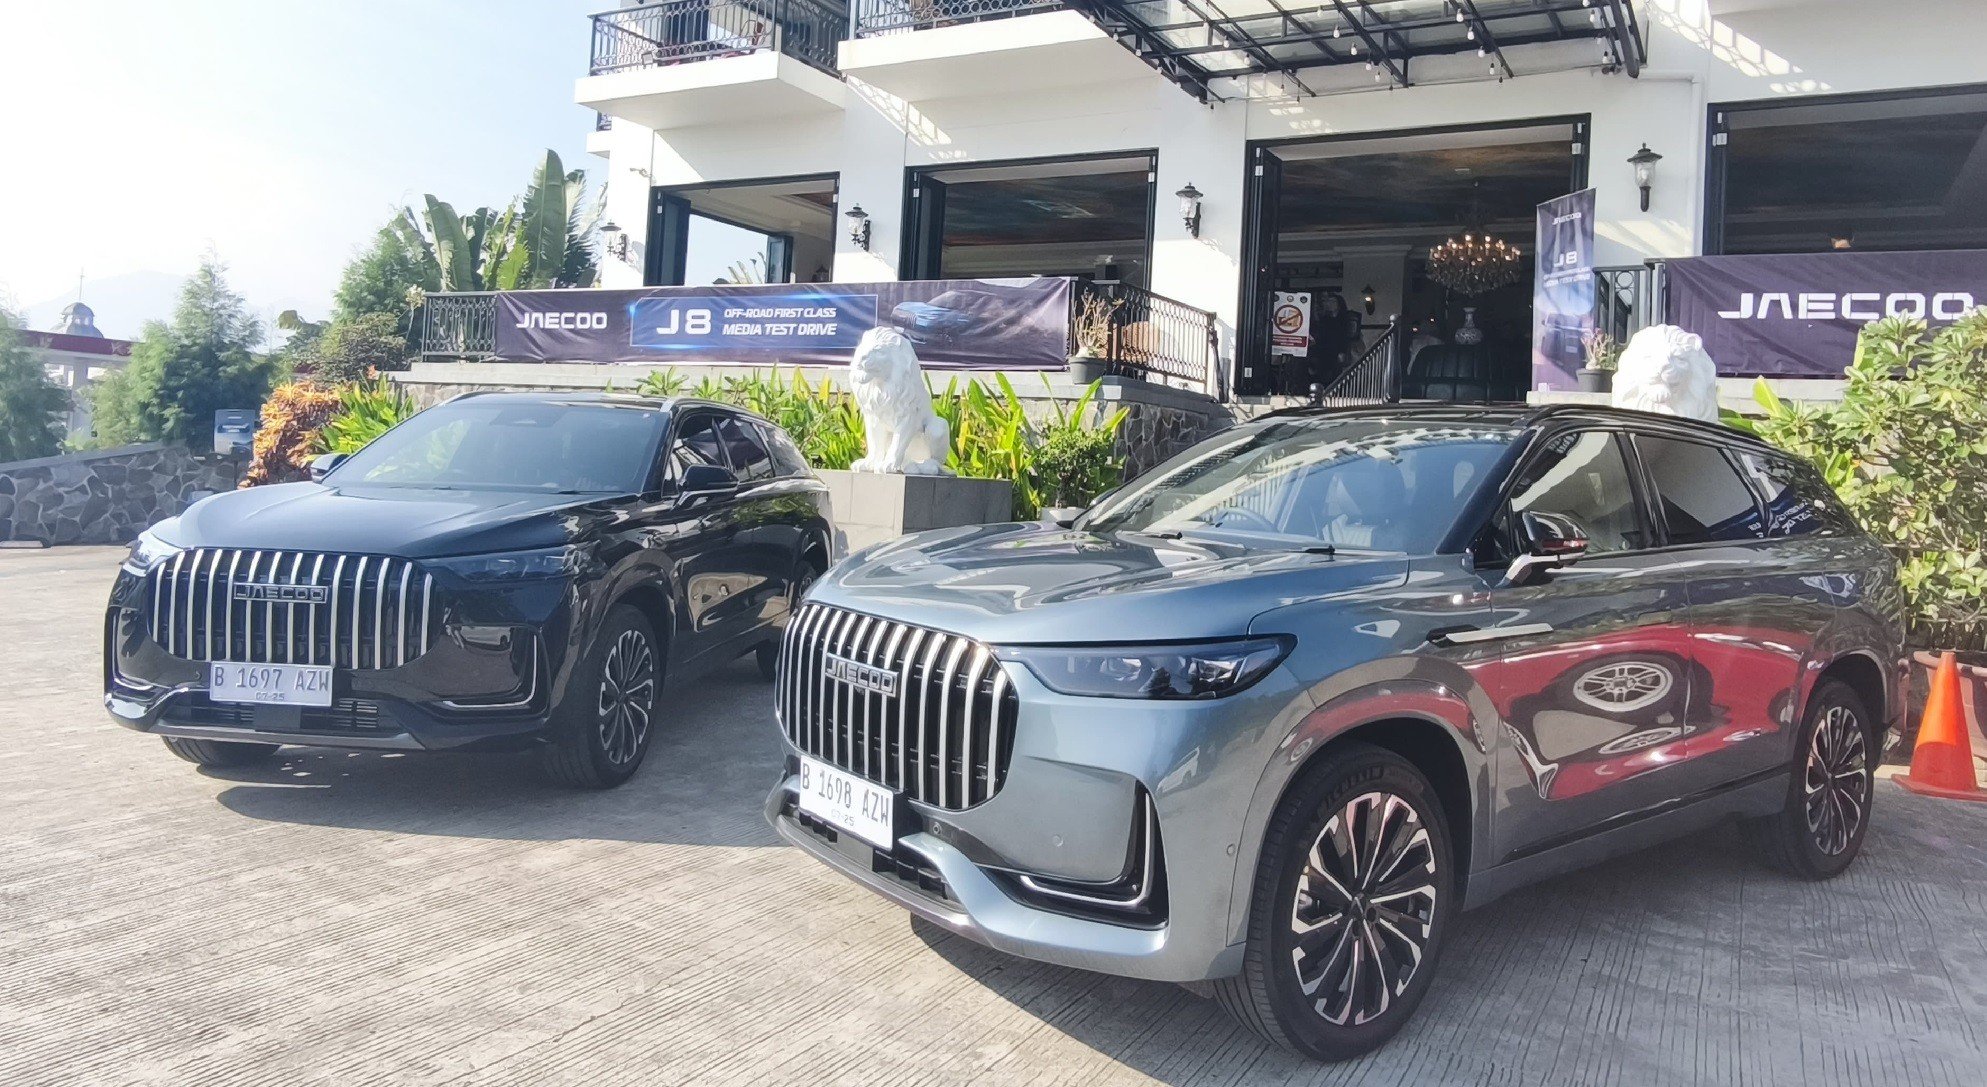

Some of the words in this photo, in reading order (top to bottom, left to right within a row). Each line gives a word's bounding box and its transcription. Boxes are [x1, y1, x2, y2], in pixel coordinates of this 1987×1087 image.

[1553, 250, 1578, 268] J8
[723, 308, 773, 318] OFF-ROAD
[774, 307, 803, 318] FIRST
[803, 307, 837, 318] CLASS
[1717, 292, 1974, 320] JAECOO
[516, 312, 608, 329] JAECOO
[656, 308, 712, 335] J8
[722, 323, 762, 336] MEDIA
[764, 323, 798, 336] TEST
[797, 323, 837, 336] DRIVE
[236, 587, 323, 600] JAECOO
[214, 666, 224, 687] B
[235, 668, 282, 688] 1697
[295, 671, 329, 691] AZW
[827, 658, 893, 693] JAECOO
[801, 762, 811, 790] B
[818, 769, 852, 809] 1698
[861, 788, 890, 828] AZW
